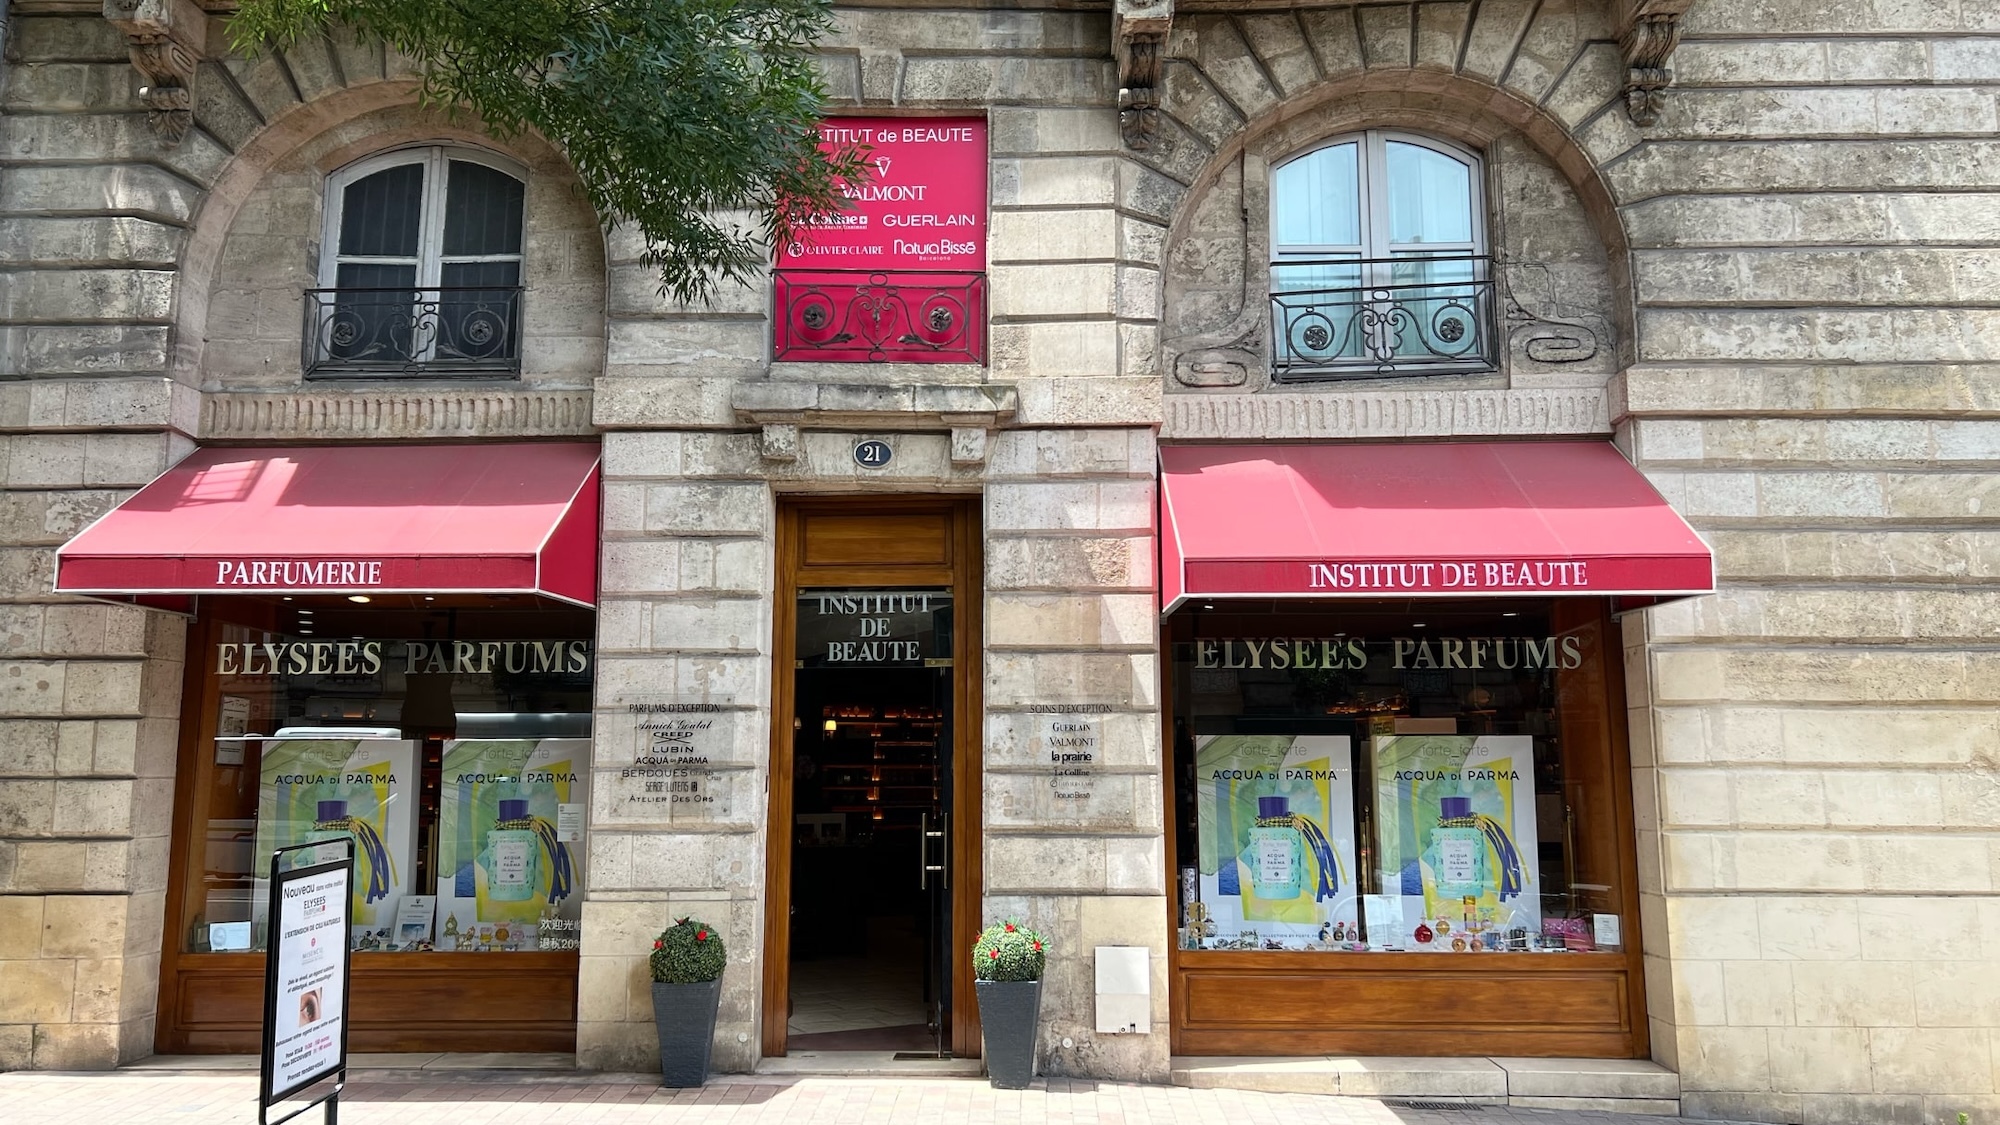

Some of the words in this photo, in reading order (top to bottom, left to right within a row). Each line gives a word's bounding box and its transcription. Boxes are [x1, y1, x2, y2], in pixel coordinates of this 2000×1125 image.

[804, 128, 873, 142] TITUT
[878, 129, 897, 143] de
[902, 128, 973, 142] BEAUTE
[840, 184, 926, 201] VALMONT
[882, 214, 975, 227] GUERLAIN
[806, 246, 848, 255] OLIVIER
[848, 246, 884, 255] CLAIRE
[863, 446, 880, 462] 21
[216, 561, 382, 585] PARFUMERIE
[1308, 563, 1434, 588] INSTITUT
[1440, 563, 1478, 587] DE
[1484, 562, 1588, 586] BEAUTE
[818, 594, 932, 615] INSTITUT
[860, 618, 891, 638] DE
[214, 642, 382, 676] ELYSEES
[404, 640, 588, 674] PARFUMS
[827, 641, 920, 662] BEAUTE
[1194, 636, 1368, 670] ELYSEES
[1391, 636, 1582, 670] PARFUMS
[629, 704, 666, 712] PARFUMS
[668, 704, 720, 712] D'EXCEPTION
[1030, 704, 1056, 714] SOINS
[1058, 704, 1112, 714] D'EXCEPTION
[635, 756, 669, 764] ACQUA
[1051, 751, 1060, 760] la
[1062, 751, 1092, 764] prairie
[274, 774, 325, 785] ACQUA
[346, 774, 397, 784] PARMA
[456, 774, 507, 784] ACQUA
[527, 773, 578, 783] PARMA
[1212, 770, 1264, 782] ACQUA
[1286, 770, 1337, 780] PARMA
[1393, 770, 1446, 782] ACQUA
[1468, 770, 1520, 780] PARMA
[283, 883, 315, 899] Nouveau
[304, 896, 326, 909] ELYSEES
